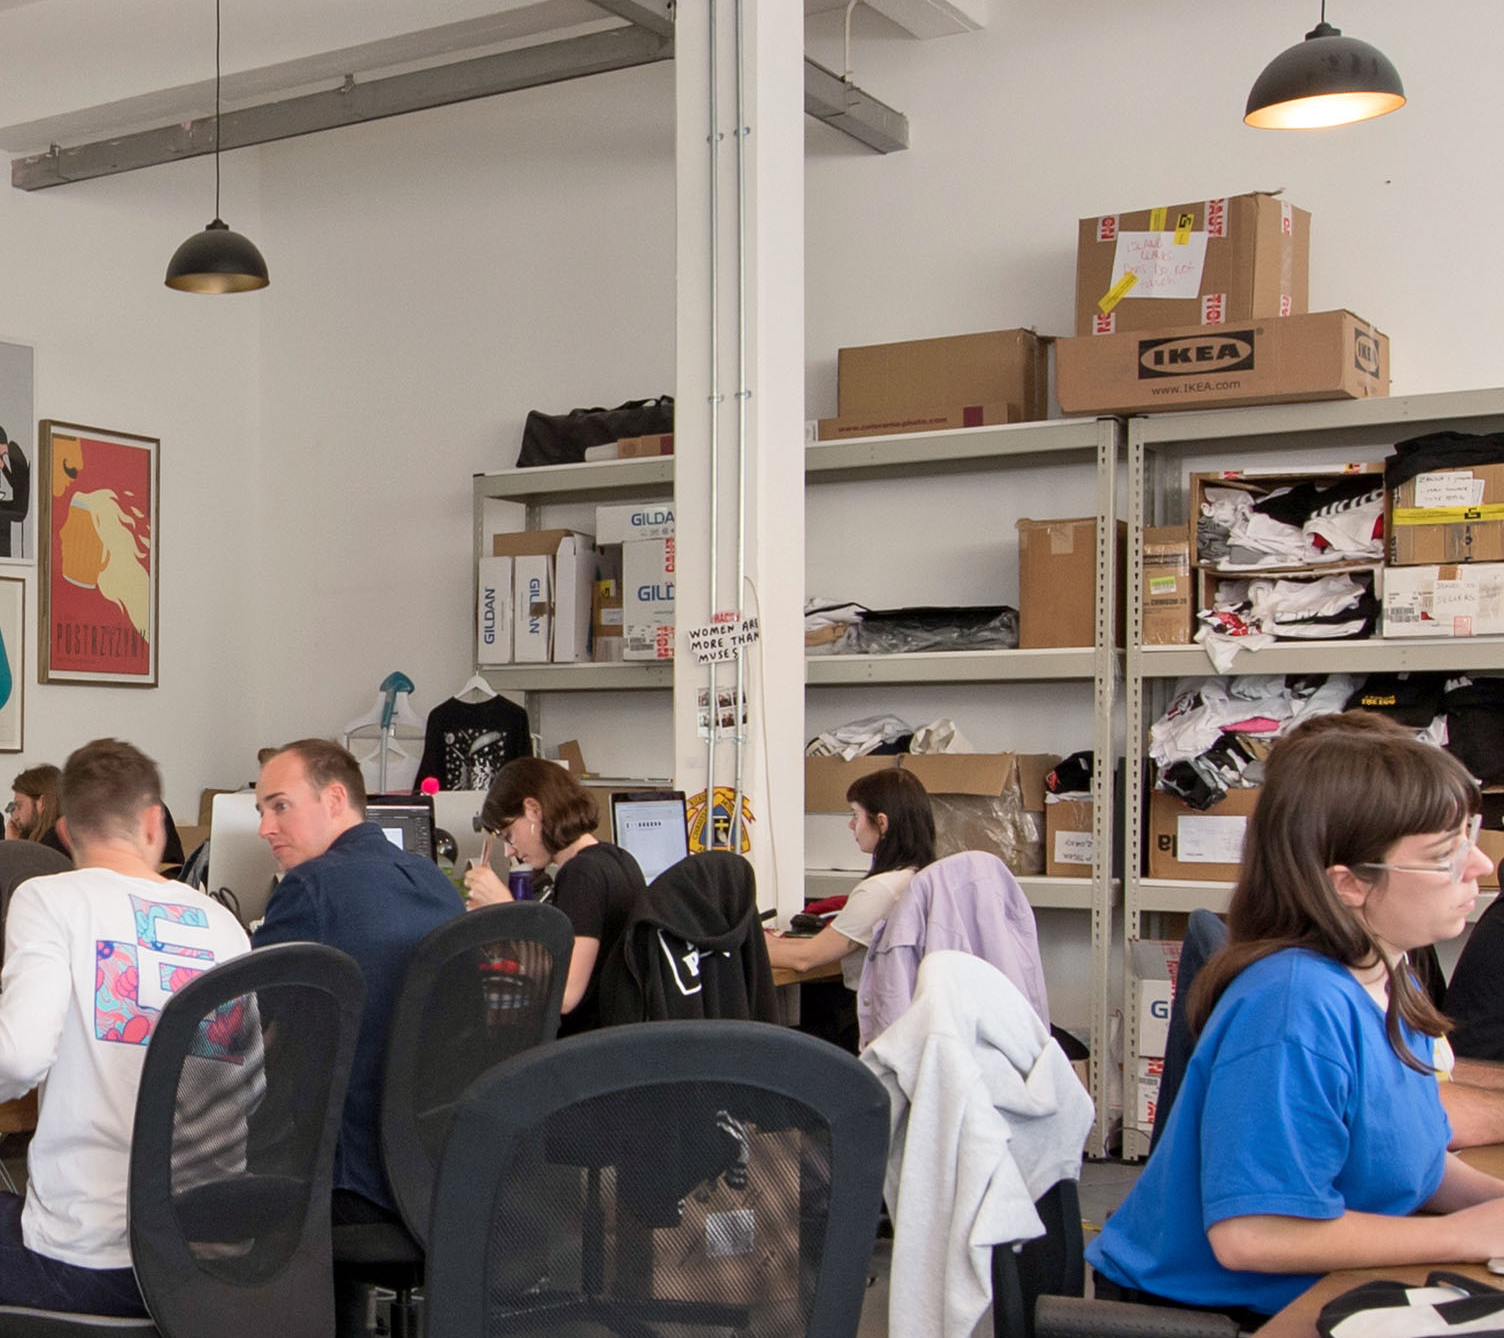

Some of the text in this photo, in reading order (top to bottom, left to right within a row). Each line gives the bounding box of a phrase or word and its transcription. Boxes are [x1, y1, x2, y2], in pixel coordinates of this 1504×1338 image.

[1154, 343, 1242, 365] IKEA
[1152, 380, 1241, 396] www.IKEA.com
[637, 585, 674, 601] GILD
[528, 578, 541, 634] GILAN
[484, 588, 496, 645] GILDAN
[689, 624, 734, 638] WOMEN
[692, 632, 759, 650] MORE THAN
[698, 647, 738, 662] MUSES
